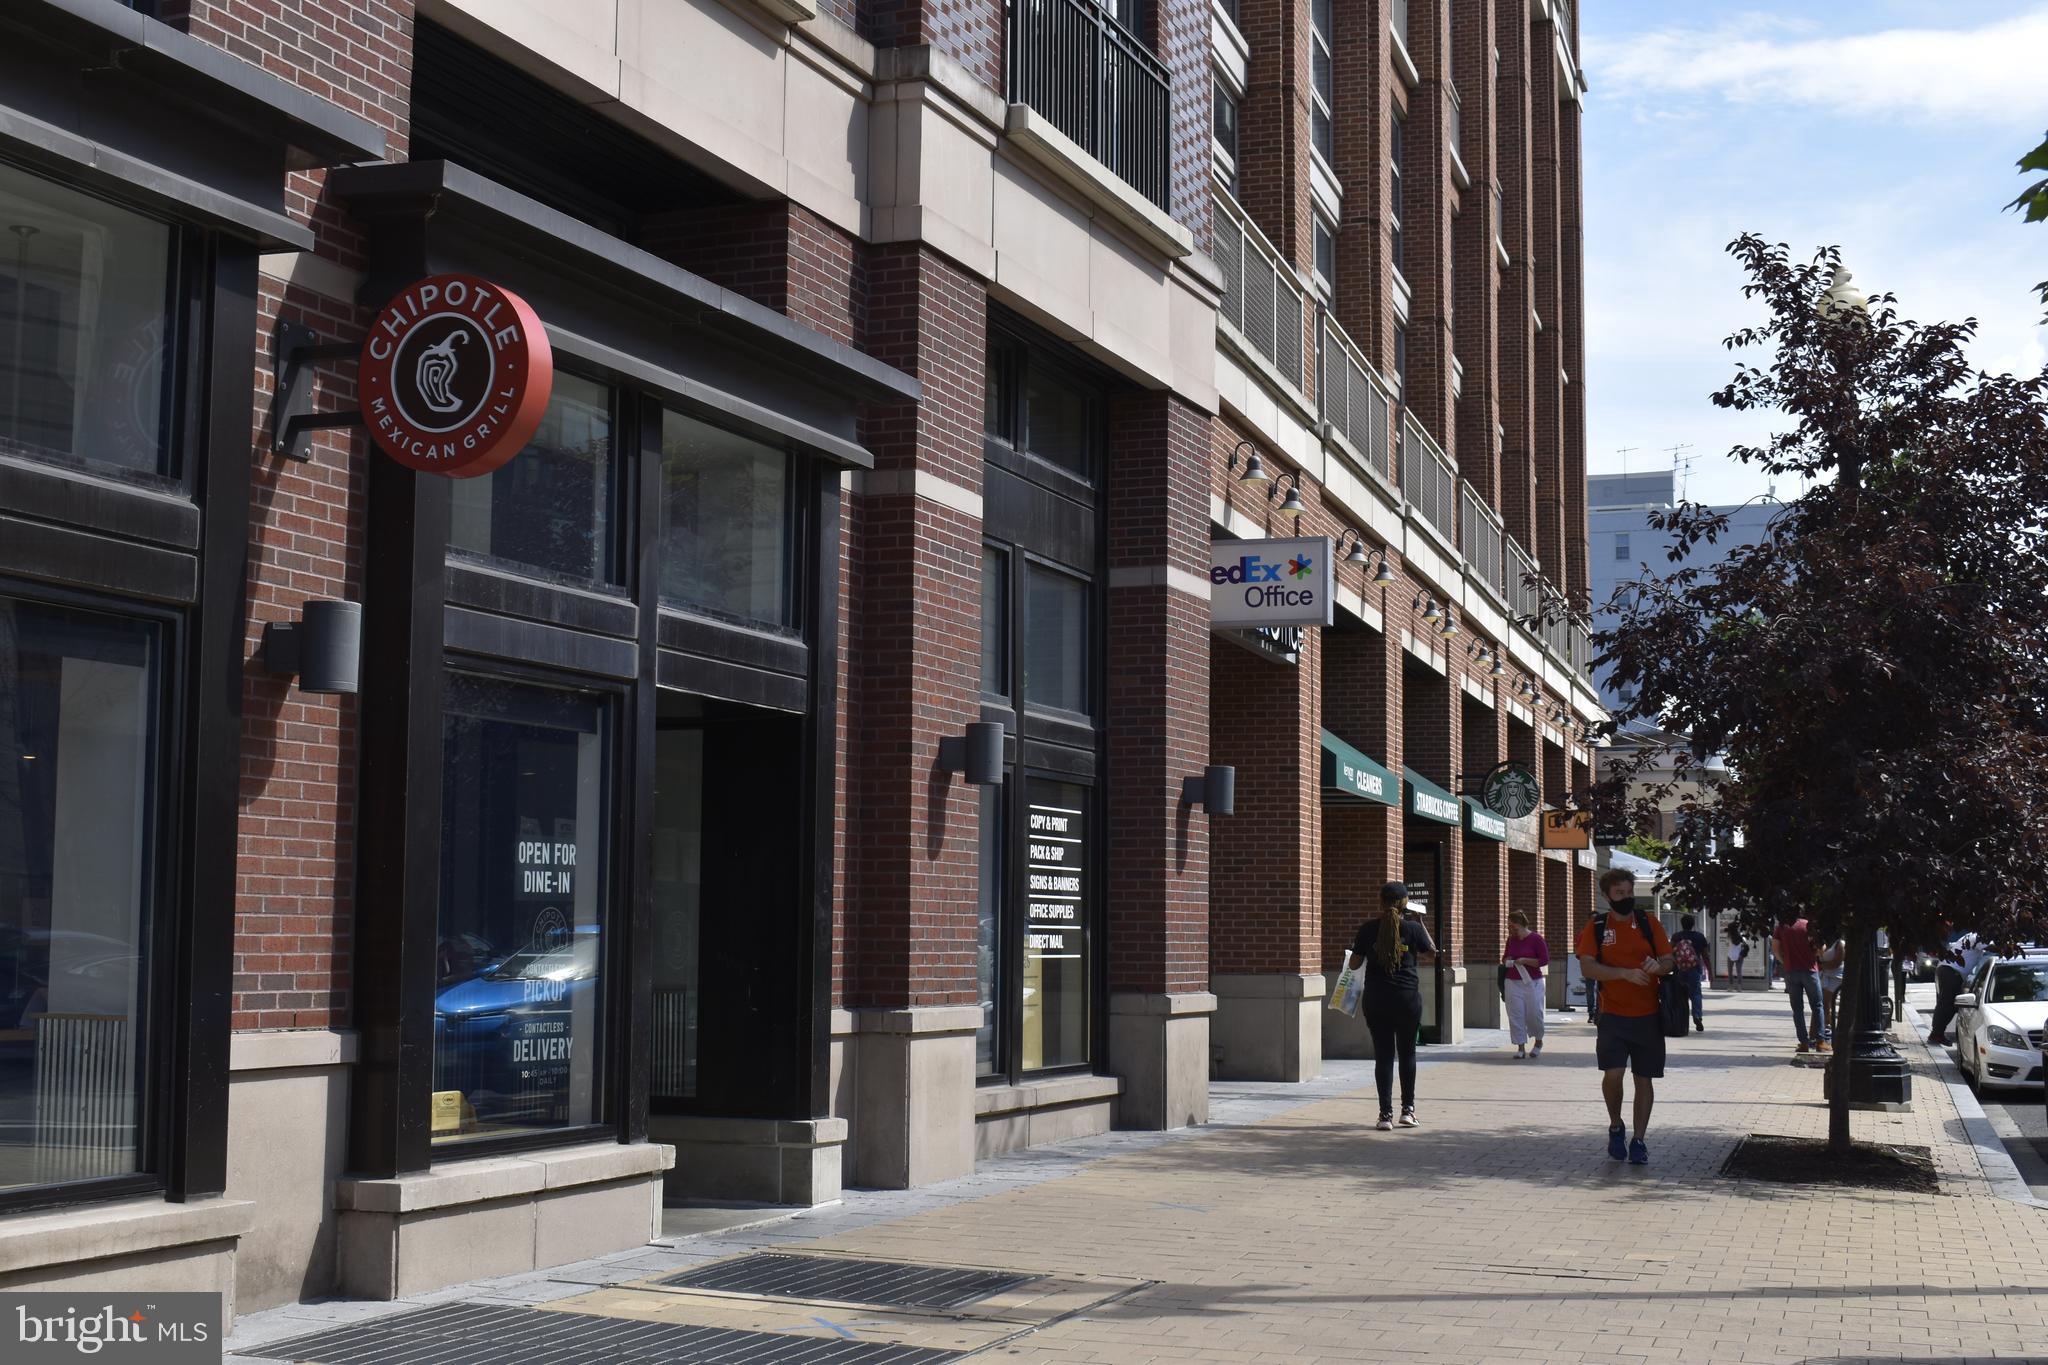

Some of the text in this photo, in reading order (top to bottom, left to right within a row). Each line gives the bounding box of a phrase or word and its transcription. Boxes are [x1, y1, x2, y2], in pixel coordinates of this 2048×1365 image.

[370, 281, 520, 360] CHIPOTLE
[372, 386, 515, 459] MEXICAN GRILL
[1210, 555, 1282, 585] edEx
[1244, 585, 1313, 608] Office
[1356, 769, 1382, 796] CLEANERS
[1442, 800, 1459, 822] COFFEE
[1030, 814, 1046, 830] COPY
[1051, 816, 1068, 832] PRINT
[518, 841, 577, 866] OPEN FOR
[1030, 844, 1045, 860] PACK
[1051, 846, 1064, 861] SHIP
[523, 870, 571, 894] DINE-IN
[1030, 874, 1047, 890] SIGNS
[1053, 876, 1080, 892] BANNERS
[1029, 903, 1074, 920] OFFICE SUPPLIES
[1029, 934, 1064, 949] DIRECT MAIL
[523, 979, 566, 1002] PICKUP
[524, 1021, 565, 1034] CONTACTLESS
[513, 1036, 574, 1062] DELIVERY
